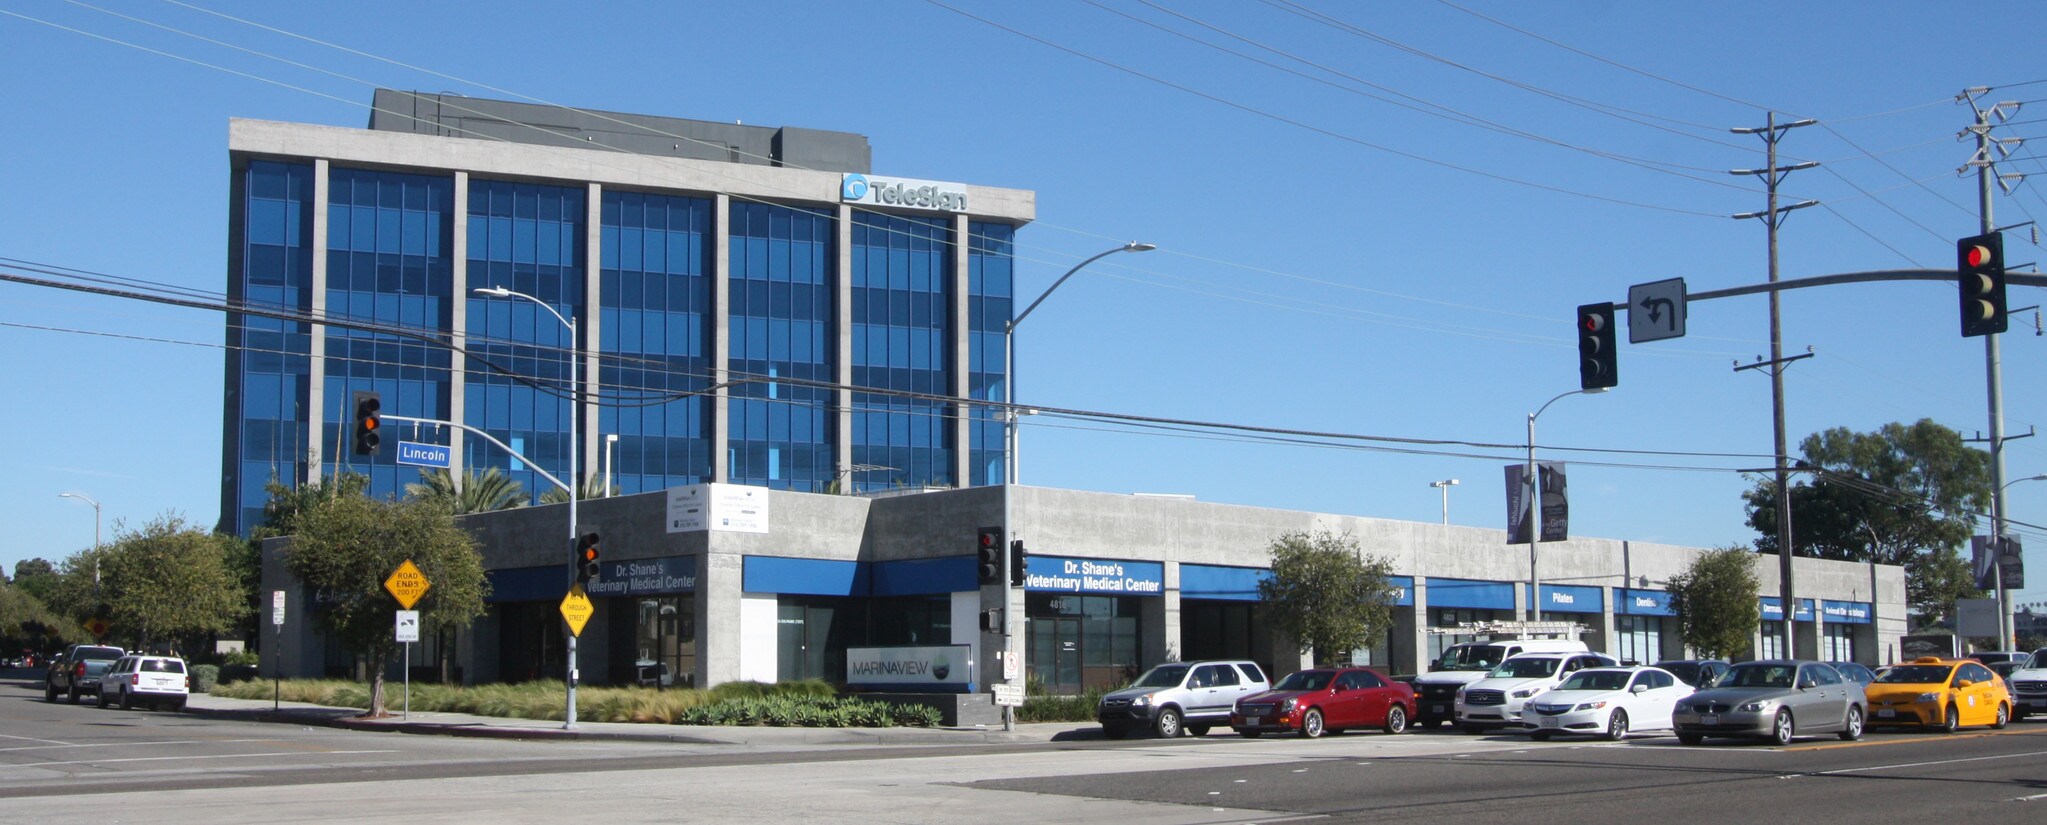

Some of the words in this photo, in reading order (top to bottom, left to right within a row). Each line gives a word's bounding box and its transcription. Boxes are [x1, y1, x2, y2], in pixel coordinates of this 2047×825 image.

[870, 181, 967, 211] TeleSign
[403, 446, 445, 462] Lincoln
[616, 564, 628, 577] Dr.
[630, 562, 664, 575] Shane's
[1065, 560, 1080, 574] Dr.
[1082, 561, 1123, 576] Shane's
[587, 580, 628, 594] Veterinary
[630, 576, 664, 591] Medical
[665, 575, 696, 588] Center
[1026, 574, 1081, 592] Veterinary
[1083, 576, 1123, 590] Medical
[1125, 578, 1159, 592] Center
[1552, 592, 1574, 604] Pilates
[853, 661, 928, 675] MARINAVIEW
